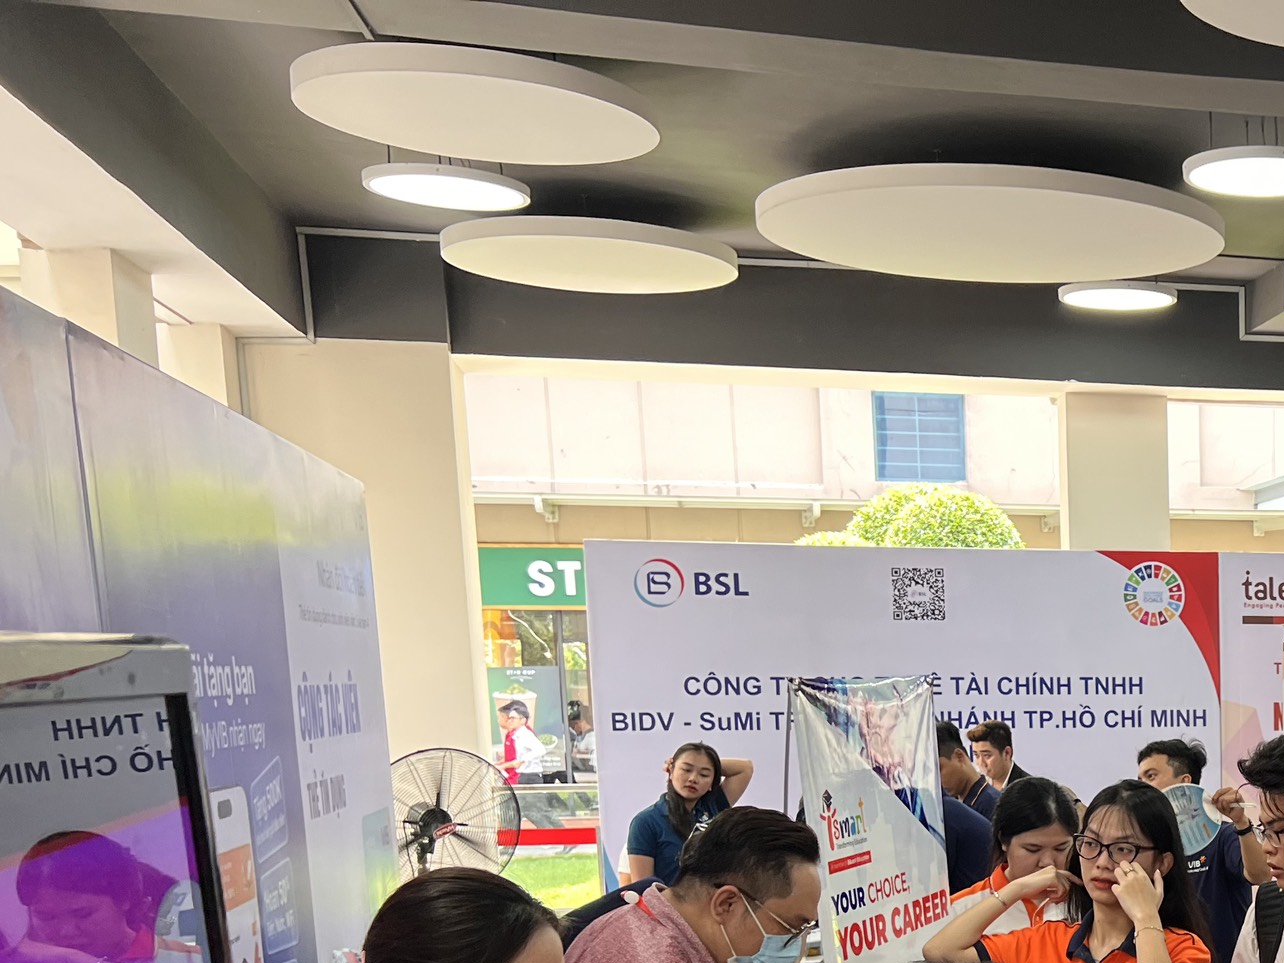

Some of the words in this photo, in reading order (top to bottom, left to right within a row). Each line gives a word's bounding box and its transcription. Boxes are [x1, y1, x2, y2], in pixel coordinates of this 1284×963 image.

[693, 573, 750, 597] BSL
[232, 655, 256, 706] bạn
[683, 671, 763, 696] CÔNG
[950, 672, 989, 695] TÀI
[996, 672, 1072, 696] CHÍNH
[1079, 676, 1144, 695] TNHH
[611, 711, 675, 732] BIDV
[699, 711, 762, 732] SuMi
[1023, 704, 1097, 729] TP.HỒ
[1103, 705, 1142, 729] CHÍ
[1150, 708, 1207, 728] MINH
[831, 886, 866, 916] YOUR
[867, 872, 911, 904] CHOICE,
[837, 913, 889, 961] YOUR
[891, 889, 949, 939] CAREER
